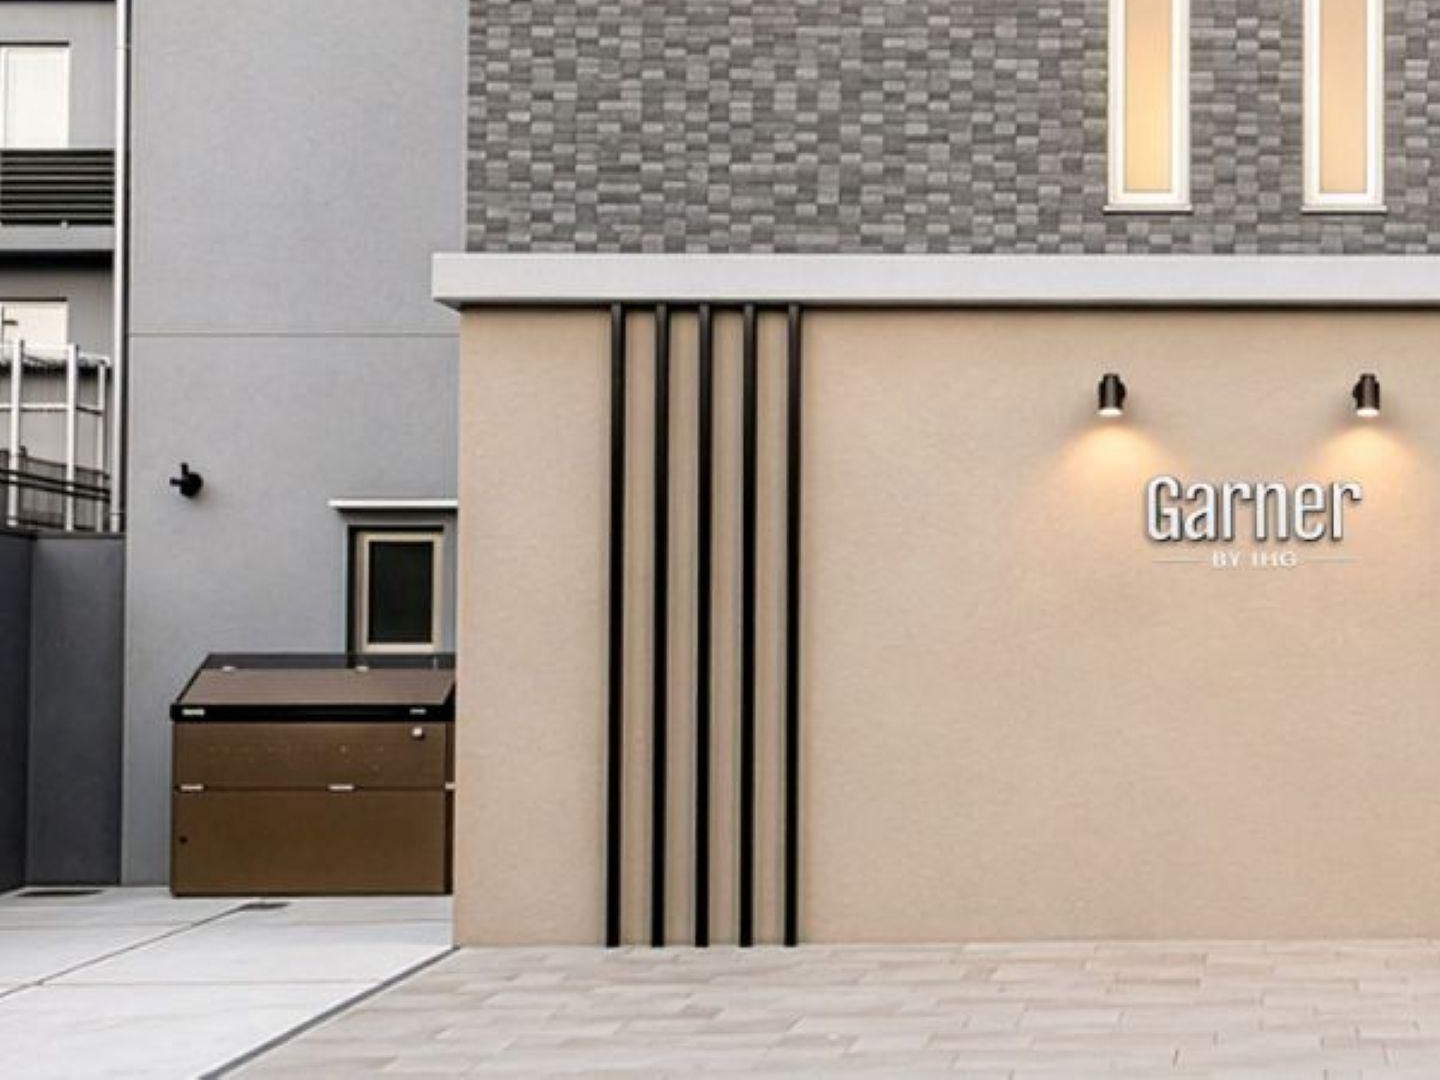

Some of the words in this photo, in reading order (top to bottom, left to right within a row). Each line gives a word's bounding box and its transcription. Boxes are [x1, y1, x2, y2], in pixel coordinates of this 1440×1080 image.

[1147, 476, 1363, 542] Garner
[1212, 550, 1241, 568] BY
[1252, 550, 1297, 568] IHG
